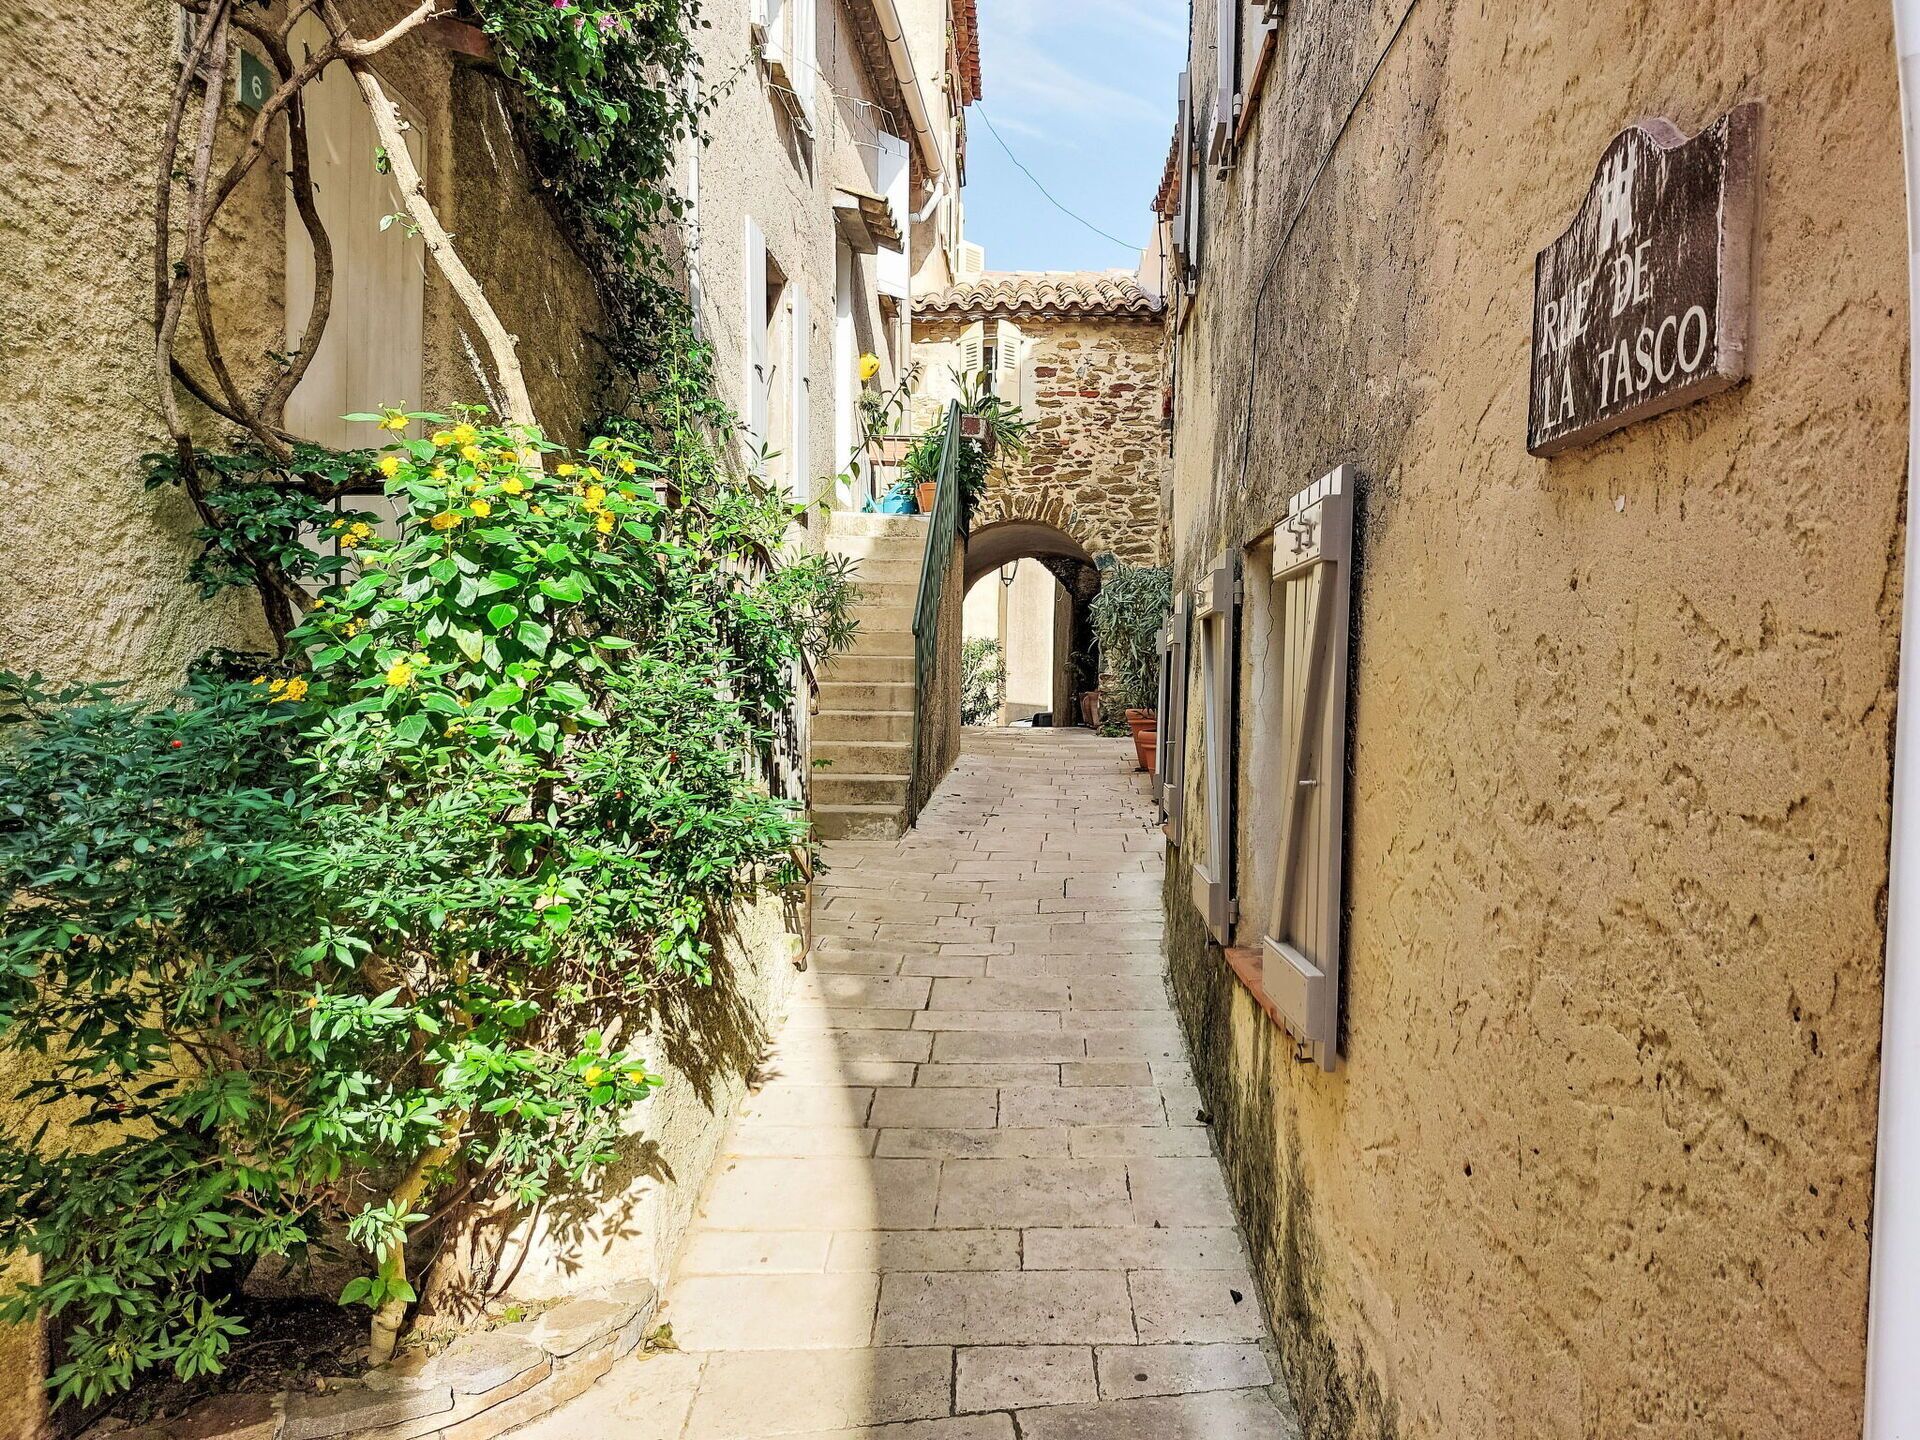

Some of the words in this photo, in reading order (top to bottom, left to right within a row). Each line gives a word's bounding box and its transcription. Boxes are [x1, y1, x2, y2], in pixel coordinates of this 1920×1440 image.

[251, 75, 263, 100] 6
[1541, 279, 1594, 356] RUE
[1612, 239, 1652, 318] DE
[1543, 365, 1576, 430] LA
[1599, 305, 1707, 410] TASCO
